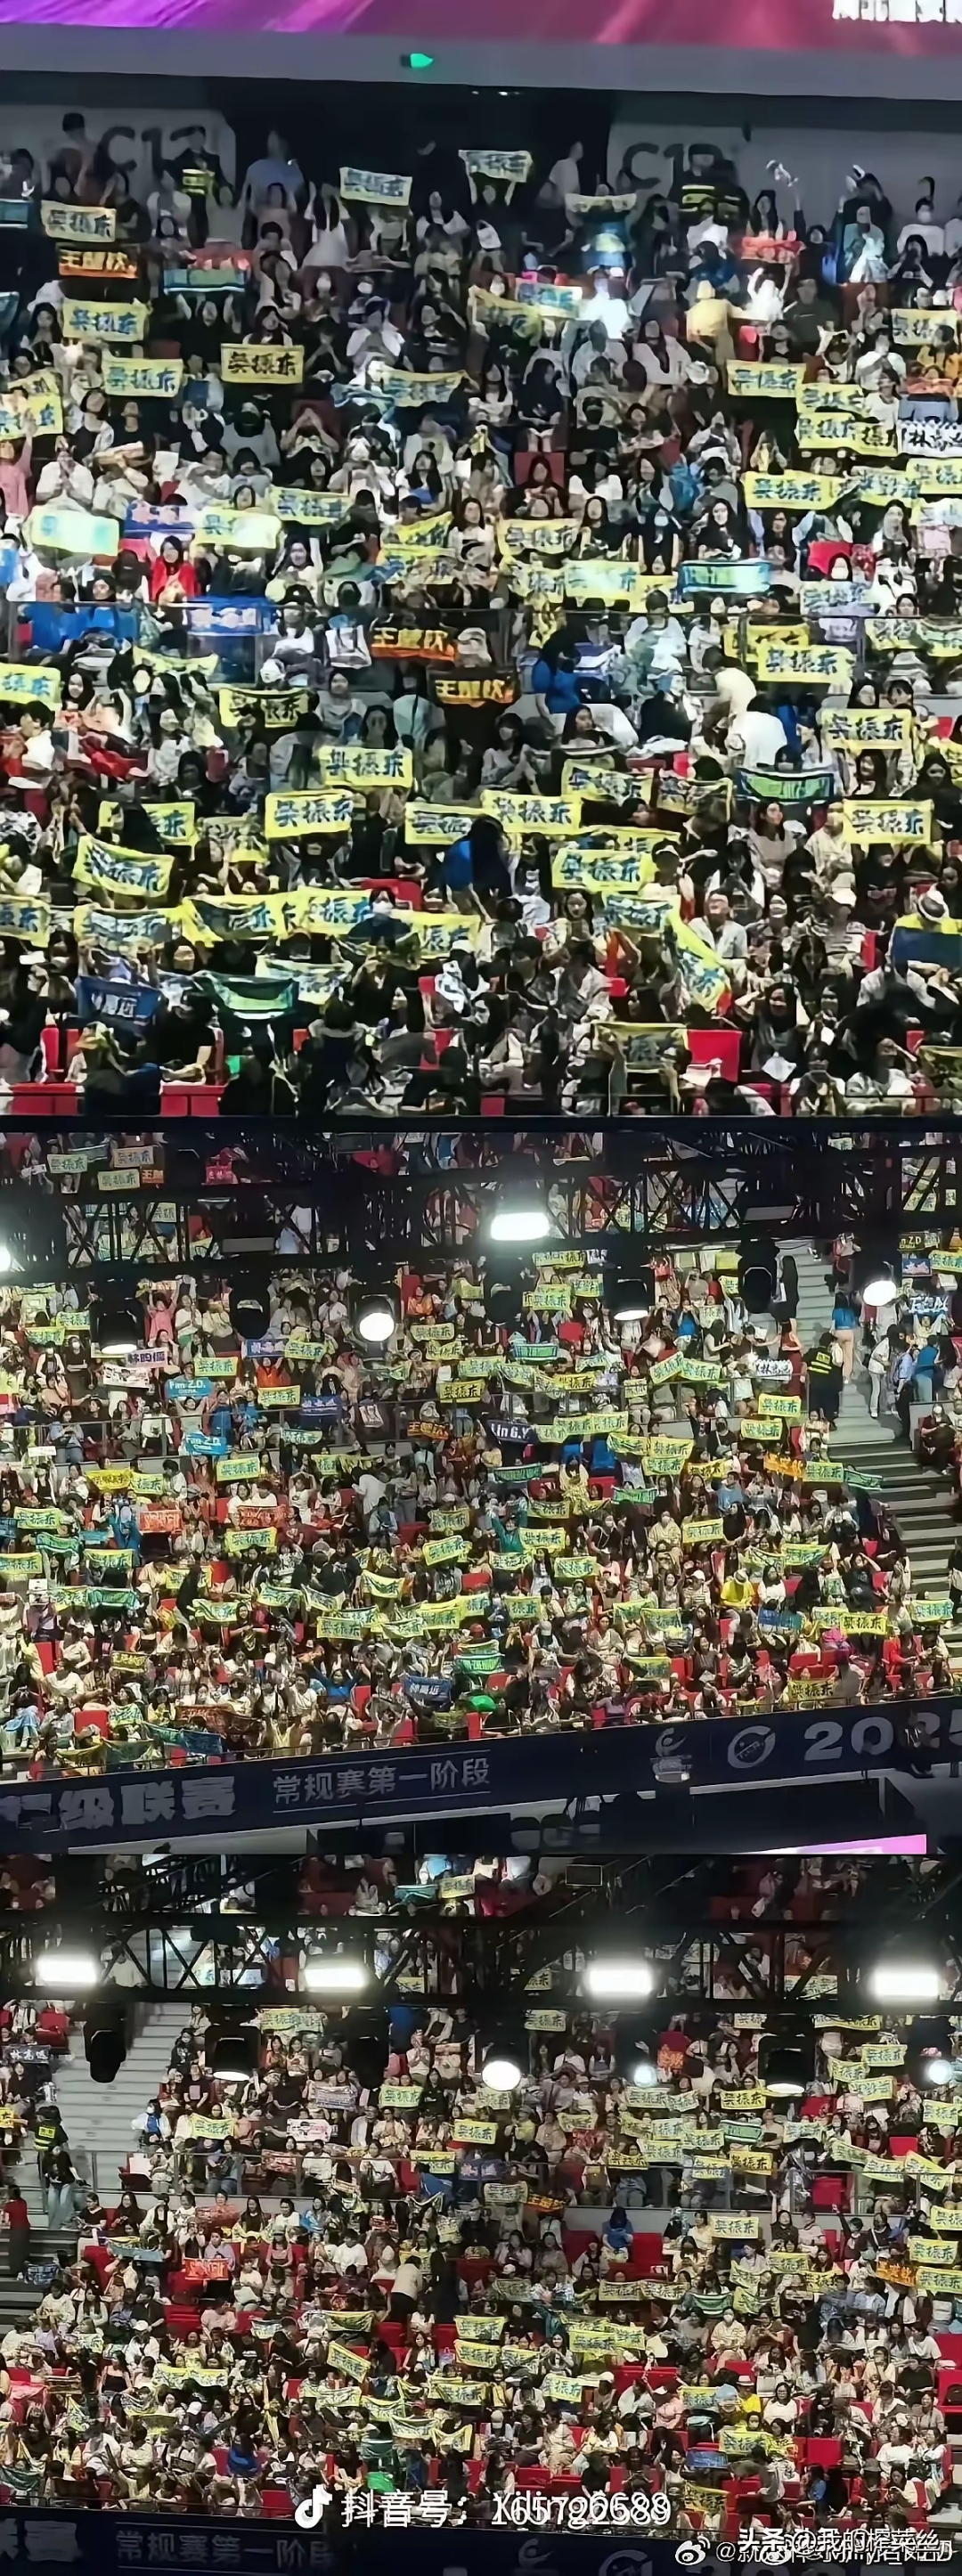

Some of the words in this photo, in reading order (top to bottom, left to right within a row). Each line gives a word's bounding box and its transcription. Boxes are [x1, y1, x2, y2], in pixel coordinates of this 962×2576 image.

[274, 1757, 490, 1806] 常规赛第一阶段
